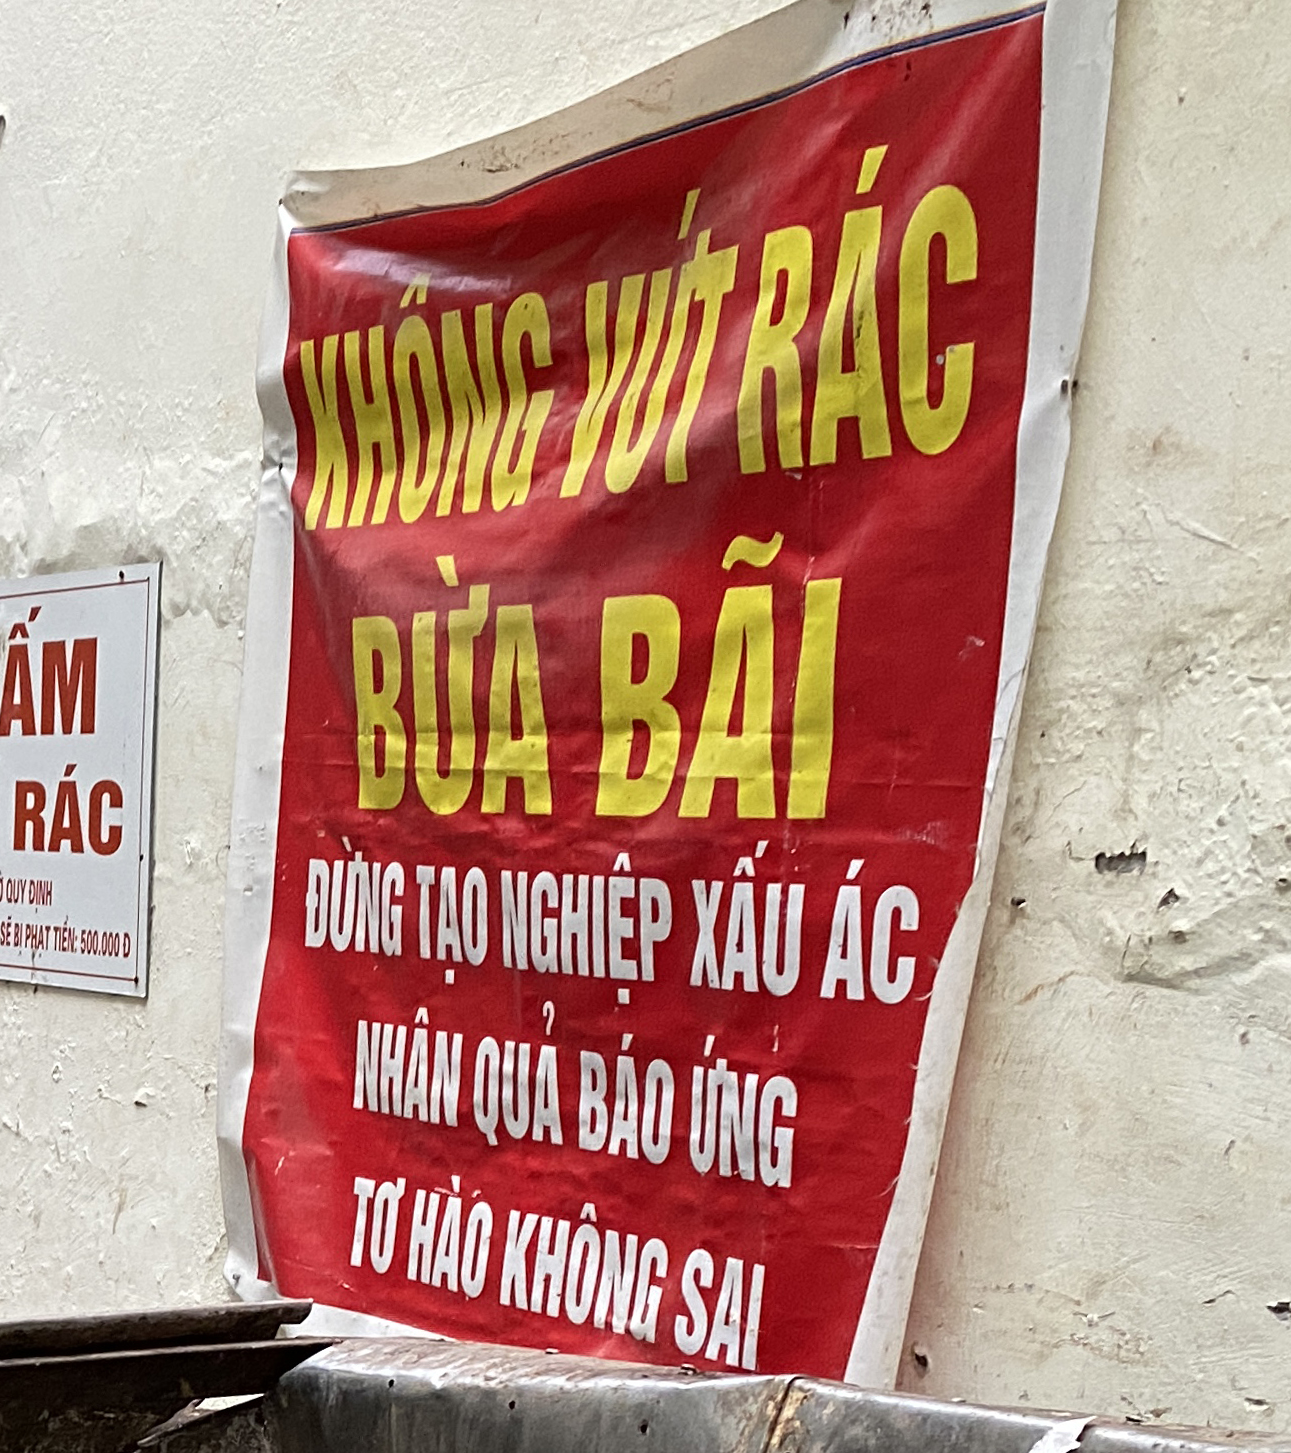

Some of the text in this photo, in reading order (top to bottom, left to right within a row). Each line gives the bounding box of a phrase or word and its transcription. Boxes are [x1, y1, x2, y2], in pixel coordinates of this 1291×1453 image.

[300, 146, 979, 530] KHÔNG VỨT RÁC
[352, 532, 842, 820] BỪA BÃI
[6, 878, 27, 905] QUY
[28, 879, 53, 914] ĐỊNH
[13, 764, 123, 856] RÁC
[0, 915, 12, 947] SẼ
[13, 922, 23, 956] BỊ
[24, 923, 51, 958] PHẠT
[80, 929, 120, 958] 500.000
[122, 931, 131, 958] Đ
[305, 836, 920, 1005] ĐỪNG TẠO NGHIỆP XẤU ÁC
[352, 1000, 798, 1188] NHÂN QUẢ BÁO ỨNG
[350, 1174, 766, 1372] TƠ HÀO KHÔNG SAI
